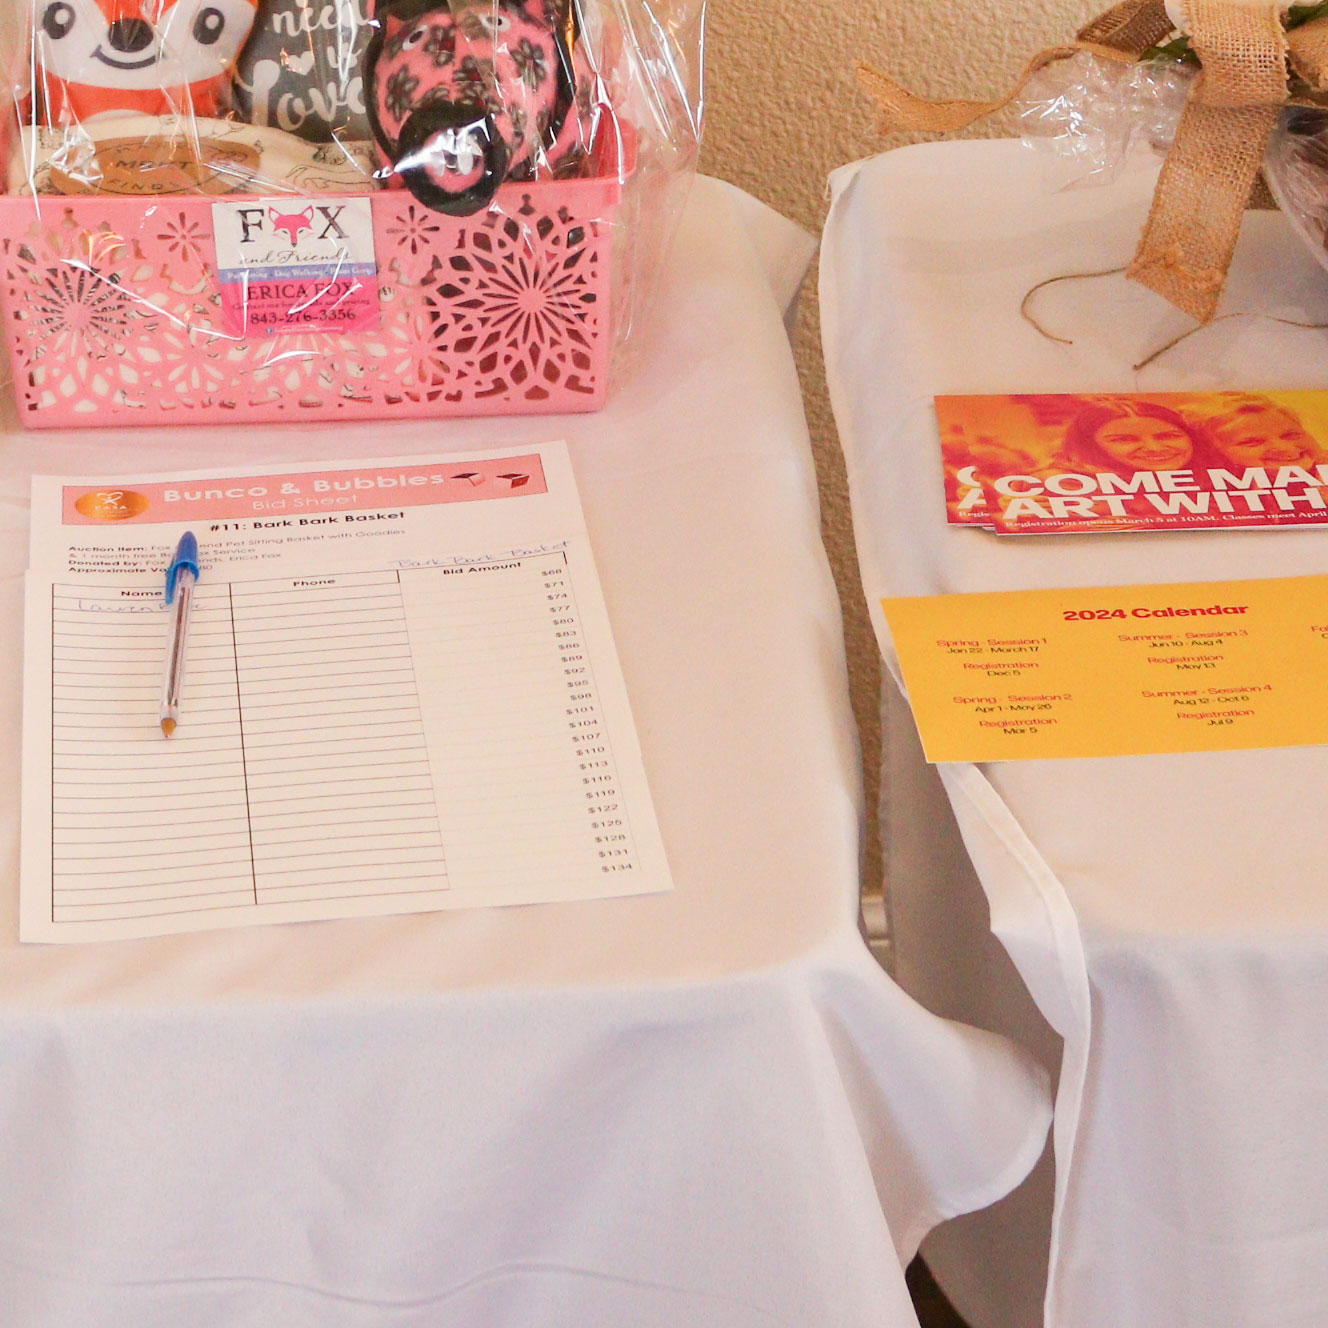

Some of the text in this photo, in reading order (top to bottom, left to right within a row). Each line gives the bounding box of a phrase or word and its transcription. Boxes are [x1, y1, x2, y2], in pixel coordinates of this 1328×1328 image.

[276, 247, 351, 264] Friends
[247, 282, 354, 300] ERICA FOX
[250, 309, 356, 324] 843-276-3356
[164, 473, 444, 502] Bunco & Bubbles
[994, 469, 1201, 496] COME
[253, 494, 359, 511] Bid Sheet
[1002, 494, 1134, 520] ART
[1145, 488, 1327, 515] WITH
[209, 511, 406, 531] #11: Bark Bark Basket
[1006, 520, 1076, 528] Registration
[1223, 513, 1264, 521] Classes
[1298, 511, 1327, 519] April
[468, 561, 522, 573] Amount
[293, 579, 336, 587] Phone
[1063, 605, 1249, 621] 2024 Calendar
[963, 662, 1039, 671] Registration
[1147, 654, 1224, 664] Registration
[1176, 708, 1255, 720] Registration
[979, 718, 1058, 728] Registration
